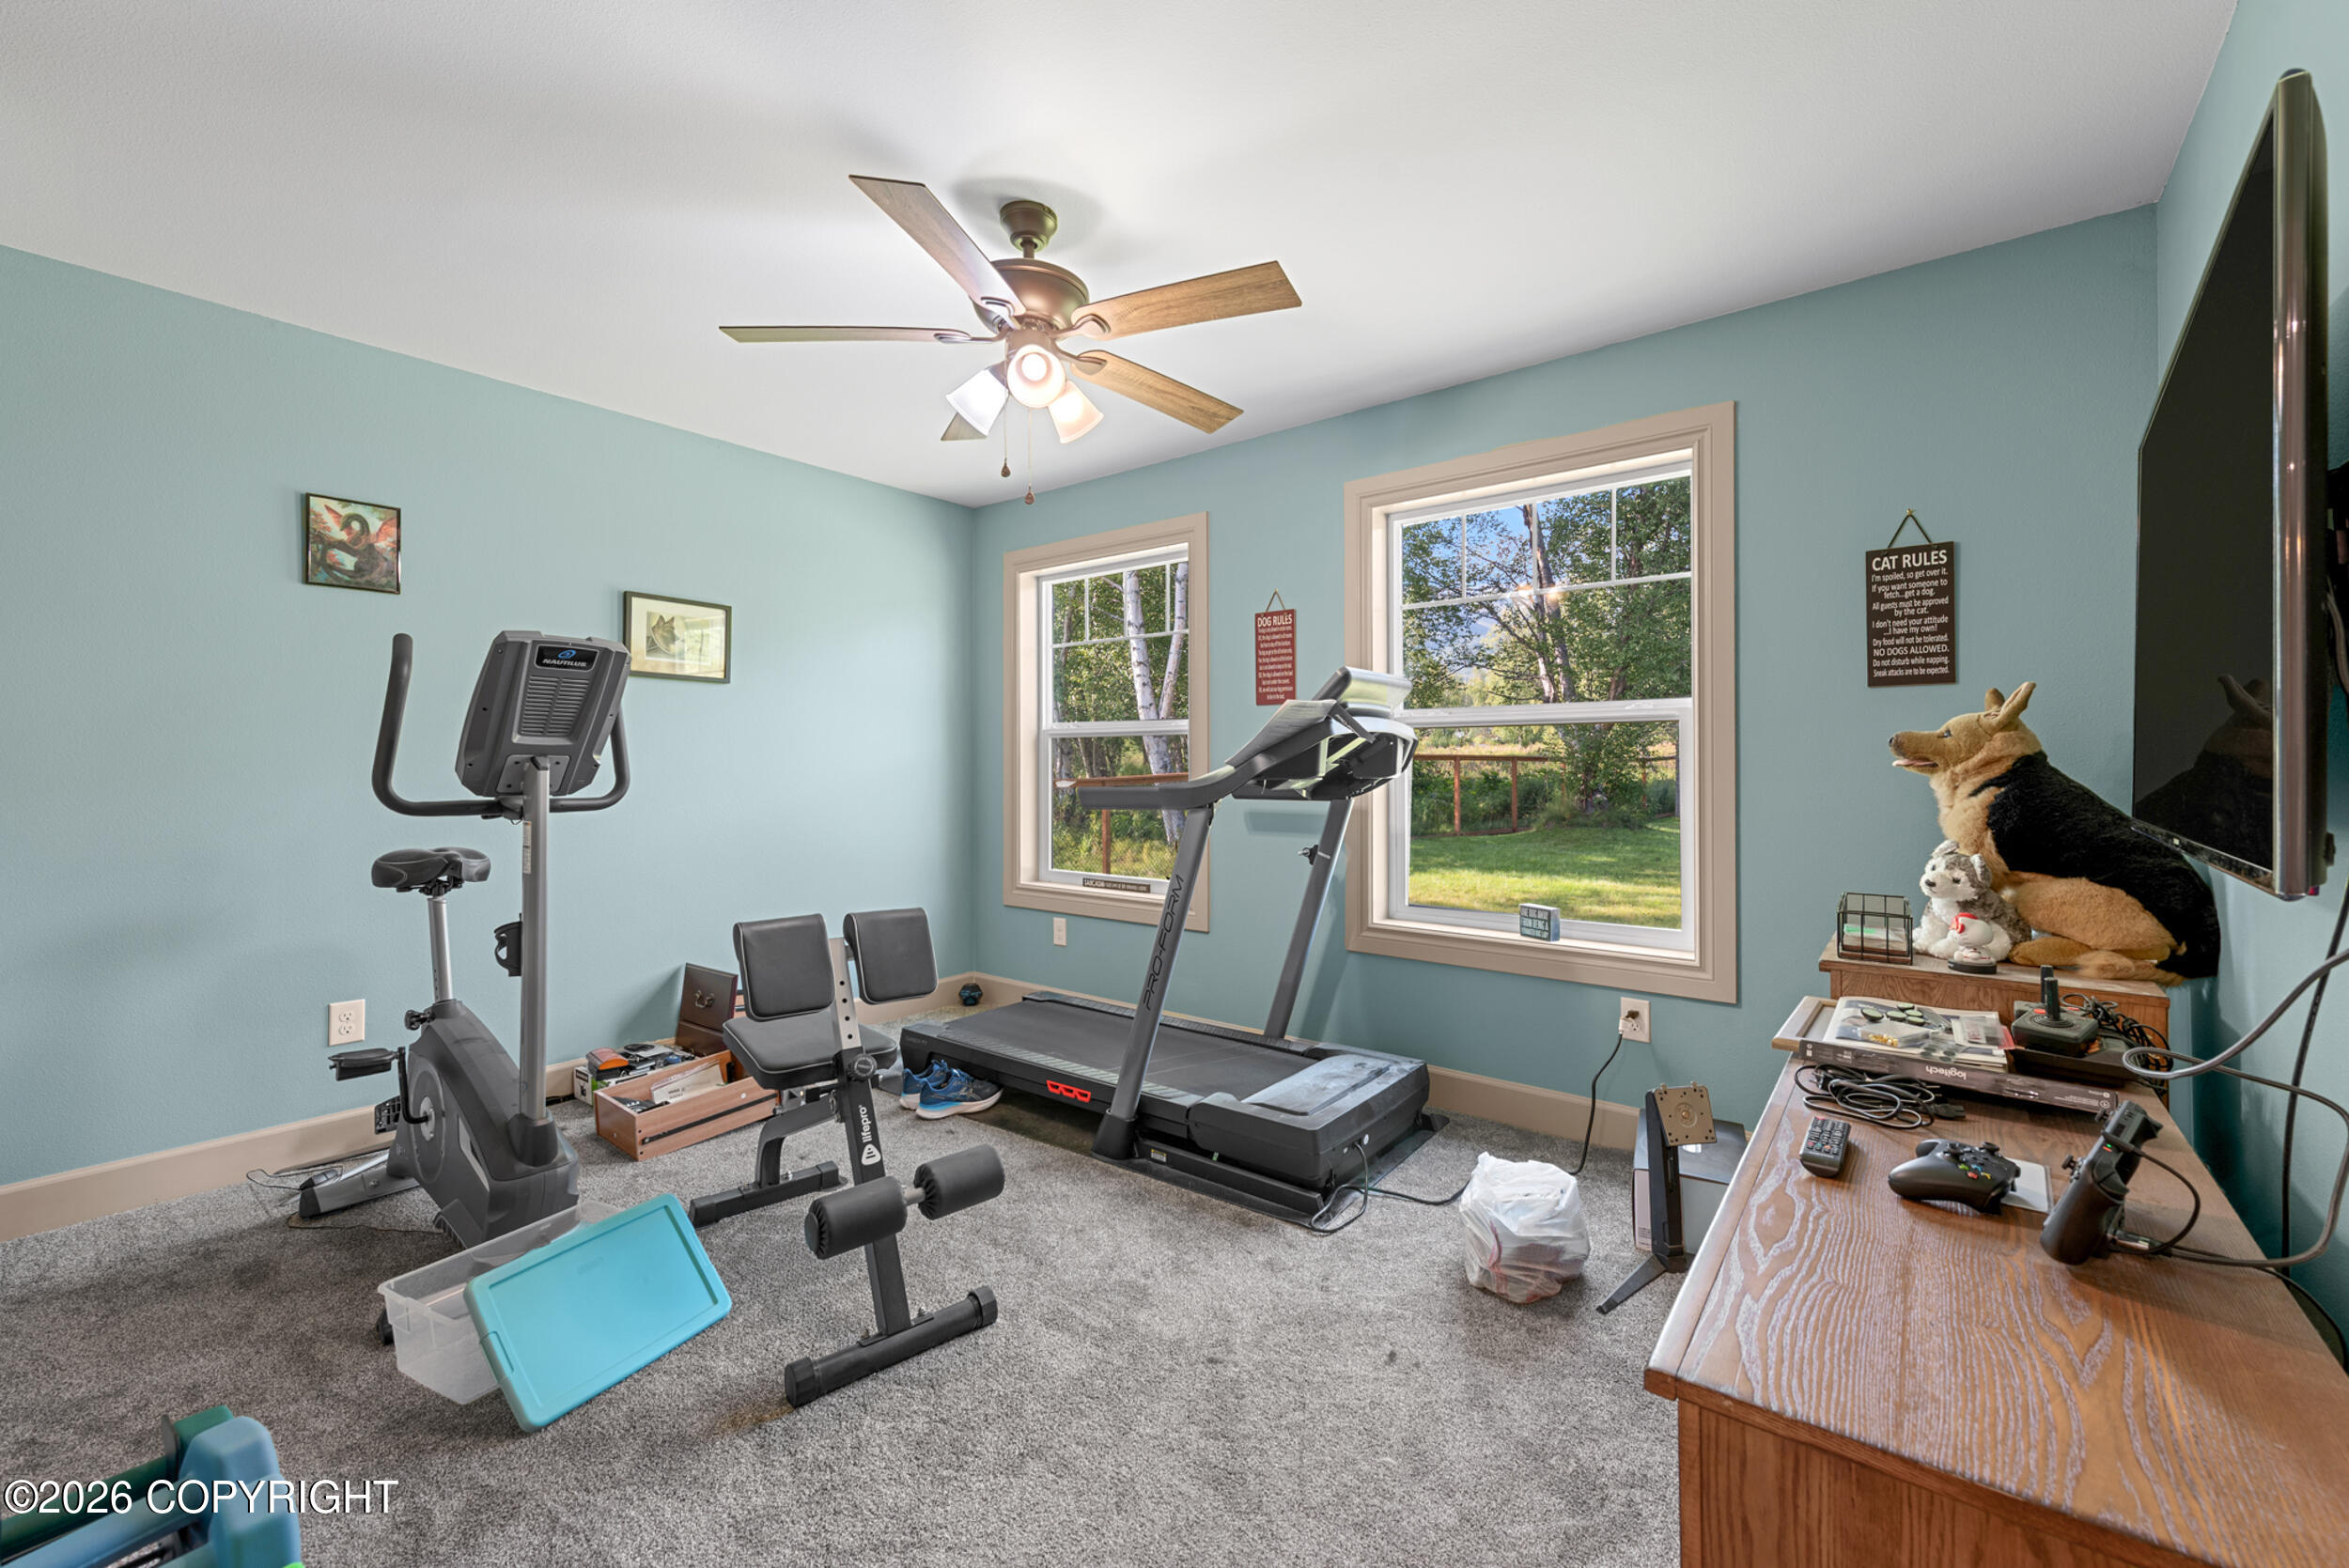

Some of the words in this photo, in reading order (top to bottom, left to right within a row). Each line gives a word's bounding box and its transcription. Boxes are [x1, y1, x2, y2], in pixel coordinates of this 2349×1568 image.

[1872, 556, 1898, 571] CAT
[1902, 550, 1947, 568] RULES
[1872, 574, 1881, 582] I'm
[1882, 571, 1905, 582] spoiled,
[1915, 570, 1925, 579] get
[1872, 584, 1876, 592] If
[1921, 588, 1935, 597] dog.
[1881, 601, 1898, 612] guests
[1922, 596, 1949, 607] approved
[1895, 608, 1903, 617] by
[1258, 617, 1271, 627] DOG
[1273, 614, 1292, 625] RULES
[1875, 619, 1891, 628] don't
[1892, 618, 1907, 627] need
[1924, 614, 1949, 624] attitude
[1921, 624, 1937, 632] own!
[1873, 639, 1881, 647] Dry
[1896, 636, 1905, 644] will
[1887, 647, 1908, 655] DOGS
[1910, 644, 1949, 654] ALLOWED.
[542, 658, 587, 667] NAUTILUS
[1891, 657, 1910, 666] disturb
[1926, 656, 1949, 665] napping.
[1143, 874, 1184, 1010] PRO-FORM
[1926, 1065, 1966, 1080] logitech
[859, 1107, 872, 1143] lifepro
